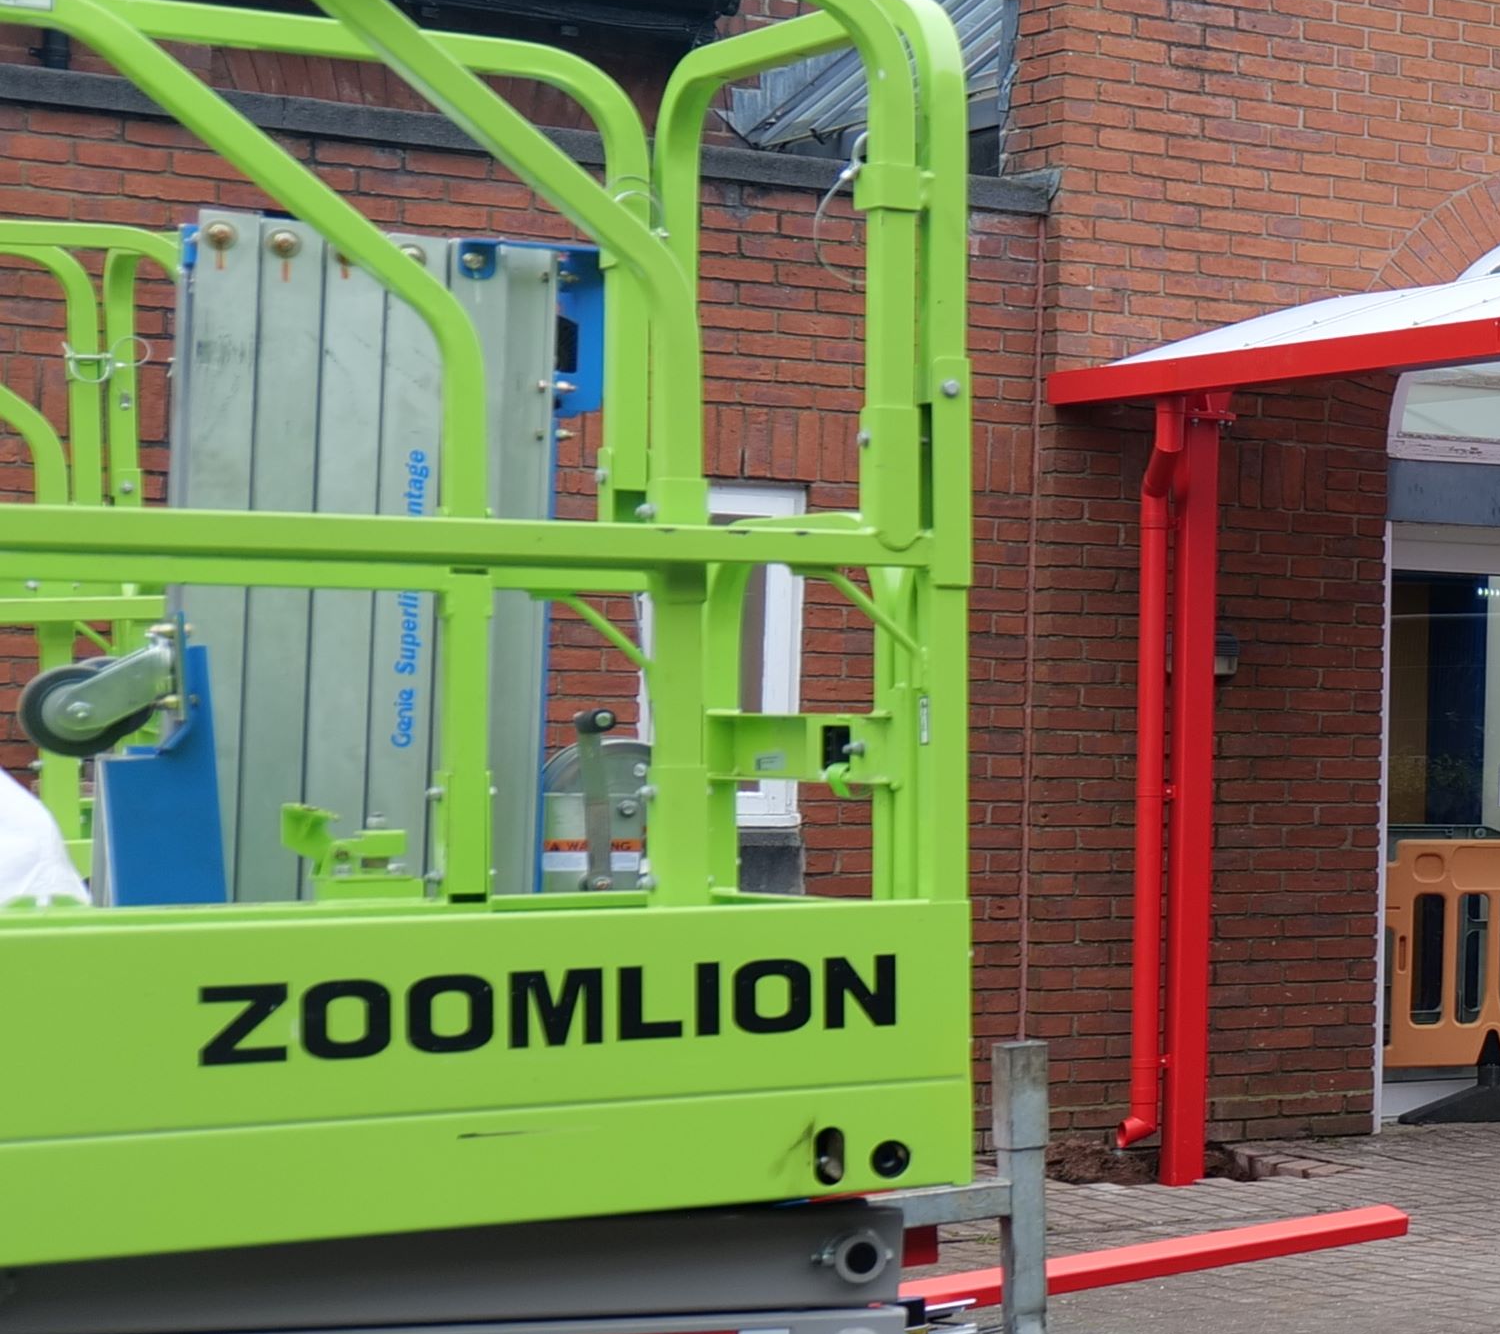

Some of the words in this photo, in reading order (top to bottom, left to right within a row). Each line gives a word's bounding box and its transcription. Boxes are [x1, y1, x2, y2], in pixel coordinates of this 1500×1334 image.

[404, 449, 430, 515] ntage
[394, 591, 421, 675] Superli
[390, 687, 415, 749] Genie
[198, 953, 898, 1065] ZOOMLION
